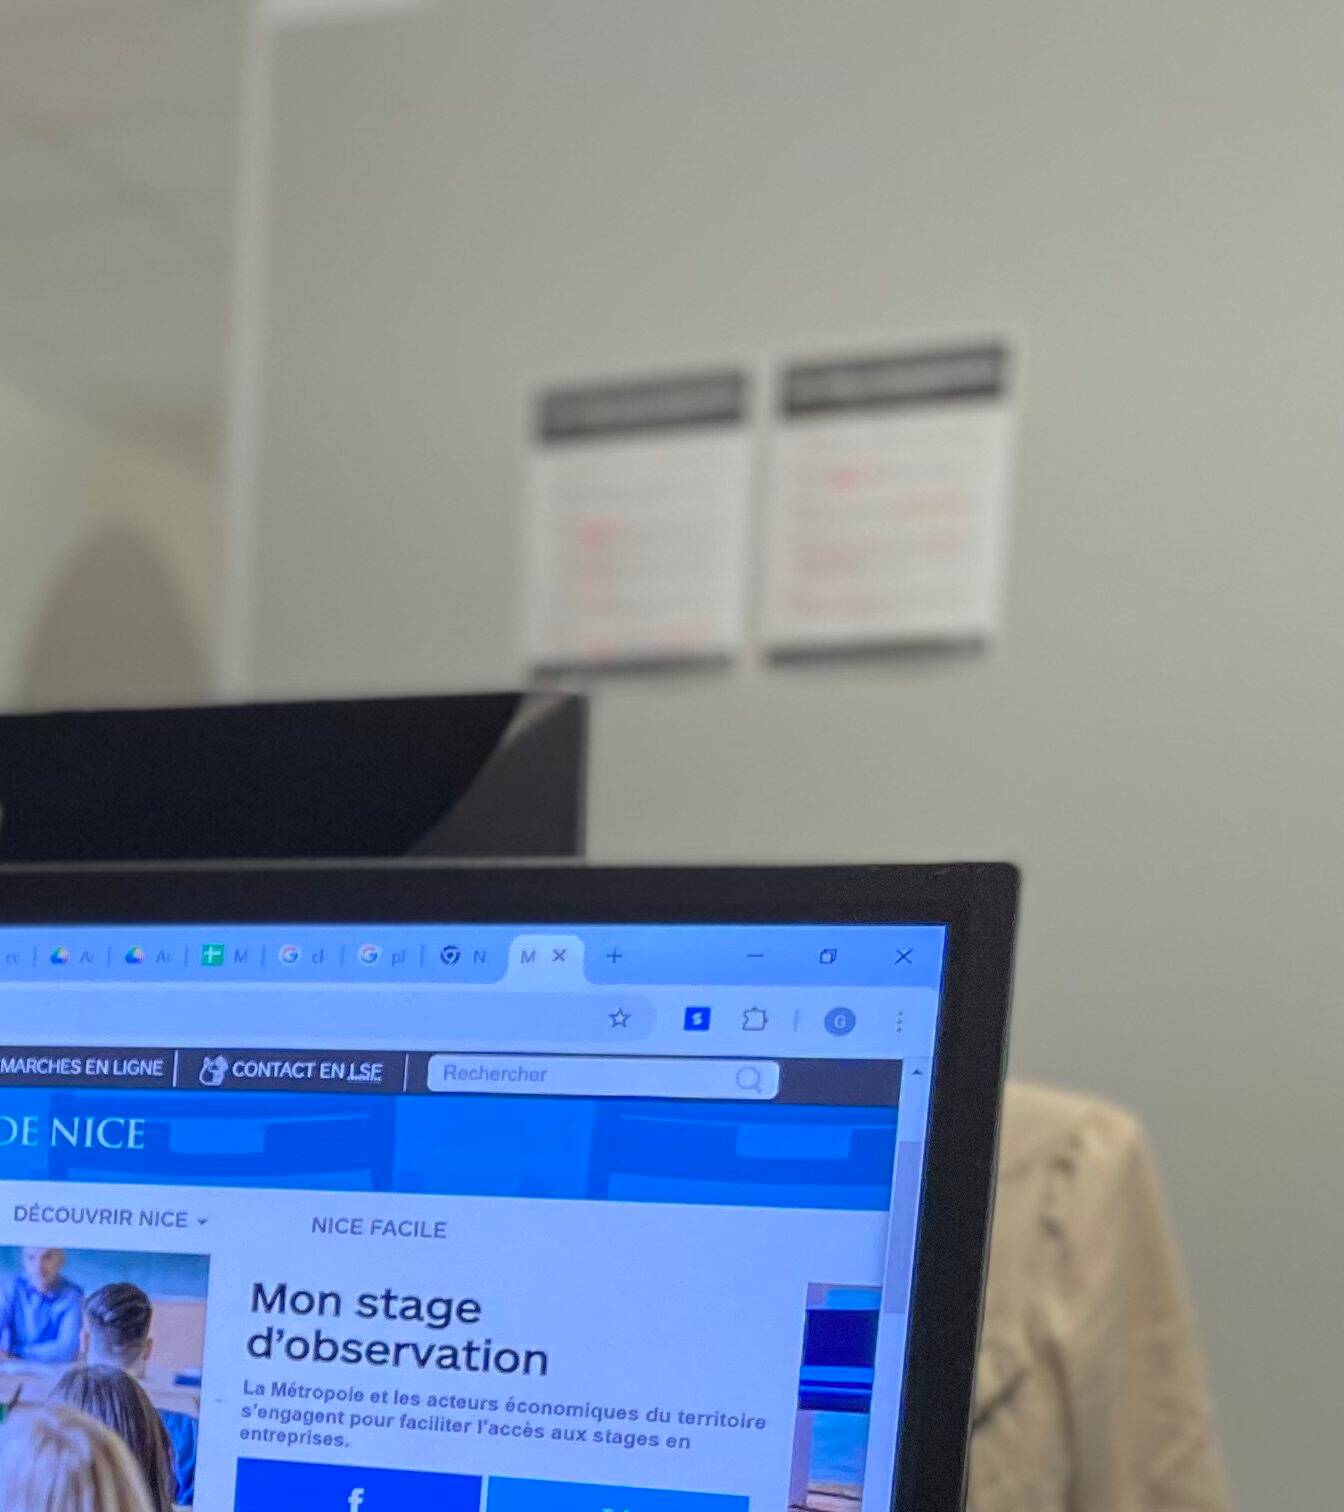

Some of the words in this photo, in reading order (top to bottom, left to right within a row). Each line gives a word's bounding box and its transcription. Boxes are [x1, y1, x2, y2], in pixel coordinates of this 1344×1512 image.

[85, 1056, 109, 1076] EN
[112, 1057, 164, 1078] LIGNE
[232, 1060, 314, 1080] CONTACT
[319, 1062, 346, 1081] EN
[443, 1064, 547, 1084] Rechercher
[50, 1116, 146, 1149] NICE
[13, 1202, 134, 1228] DÉCOUVRIR
[138, 1209, 189, 1229] NICE
[311, 1215, 363, 1236] NICE
[369, 1217, 448, 1240] FACILE
[250, 1282, 342, 1318] Mon
[355, 1286, 481, 1329] stage
[246, 1326, 549, 1376] d'observation
[243, 1379, 266, 1397] La
[270, 1380, 366, 1406] Métropole
[369, 1388, 389, 1404] et
[392, 1388, 421, 1406] les
[426, 1394, 499, 1412] acteurs
[504, 1396, 640, 1426] économiques
[645, 1406, 672, 1424] du
[677, 1408, 767, 1431] territoire
[239, 1427, 350, 1449] entreprises.
[241, 1403, 345, 1429] s'engagent
[349, 1412, 393, 1432] pour
[399, 1412, 470, 1434] faciliter
[476, 1417, 545, 1439] l'accès
[551, 1425, 588, 1443] aux
[592, 1427, 659, 1450] stages
[665, 1434, 691, 1450] en
